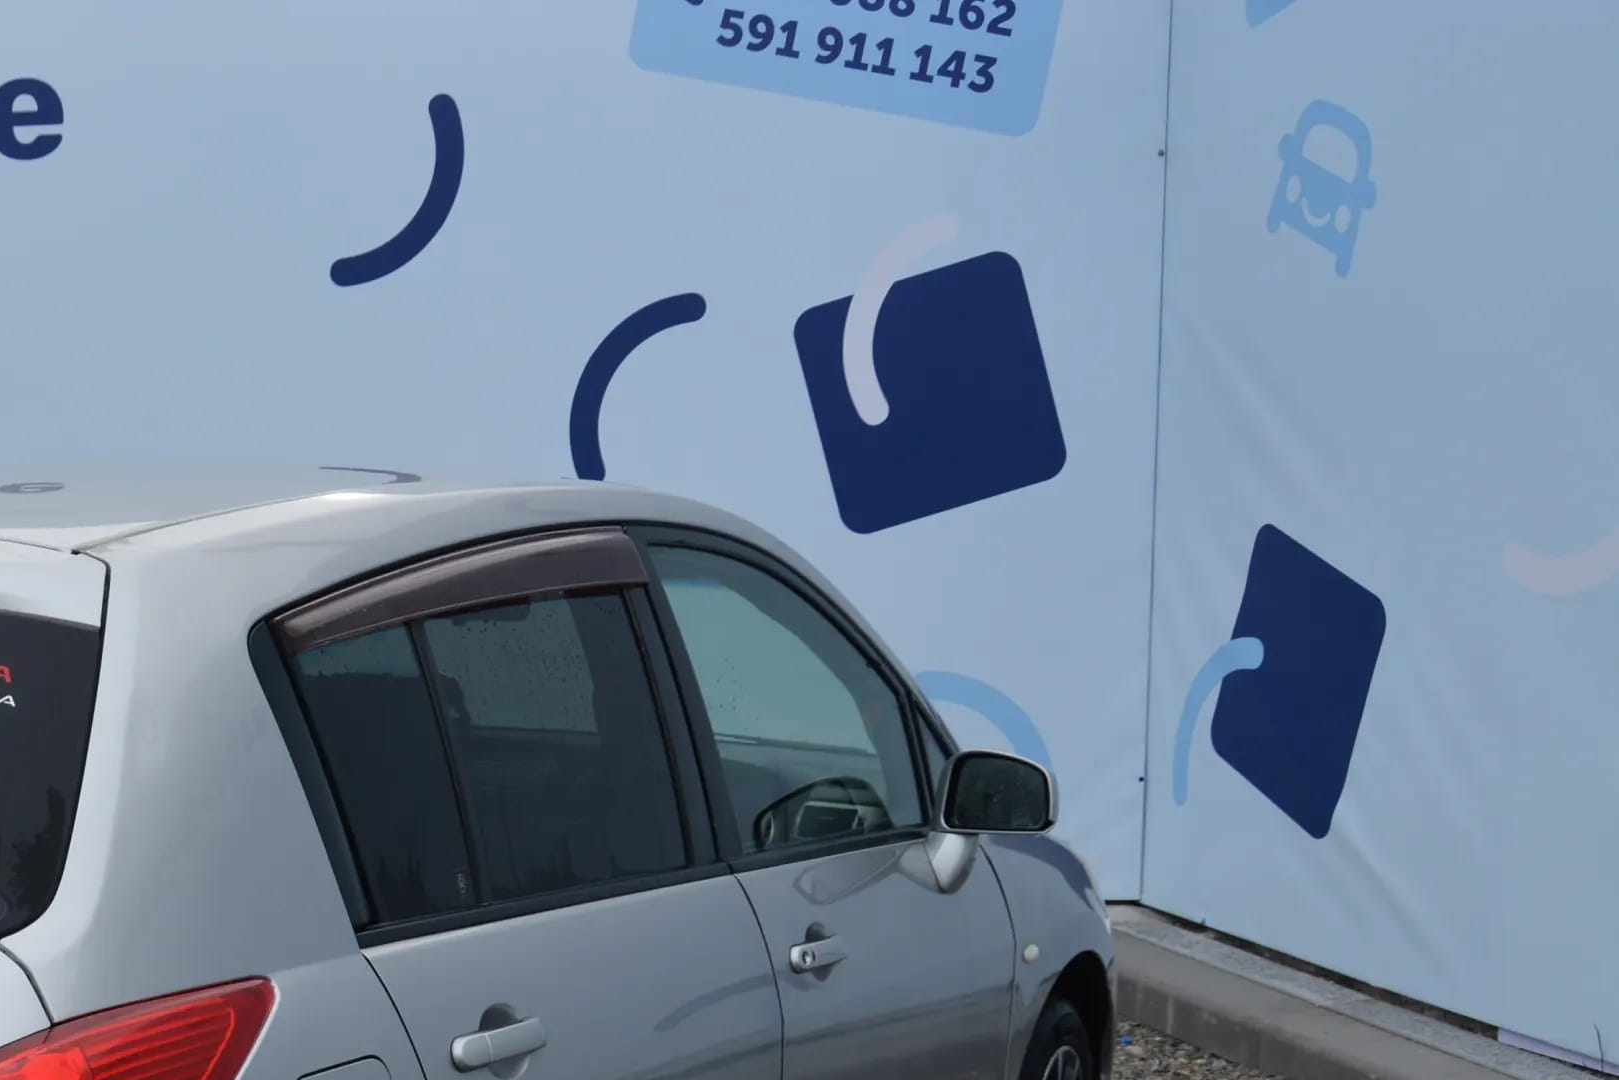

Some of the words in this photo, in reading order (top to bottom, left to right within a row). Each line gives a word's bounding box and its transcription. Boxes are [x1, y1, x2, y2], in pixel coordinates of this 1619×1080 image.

[929, 0, 1016, 37] 162
[716, 8, 800, 59] 591
[815, 26, 896, 76] 911
[909, 44, 998, 93] 143
